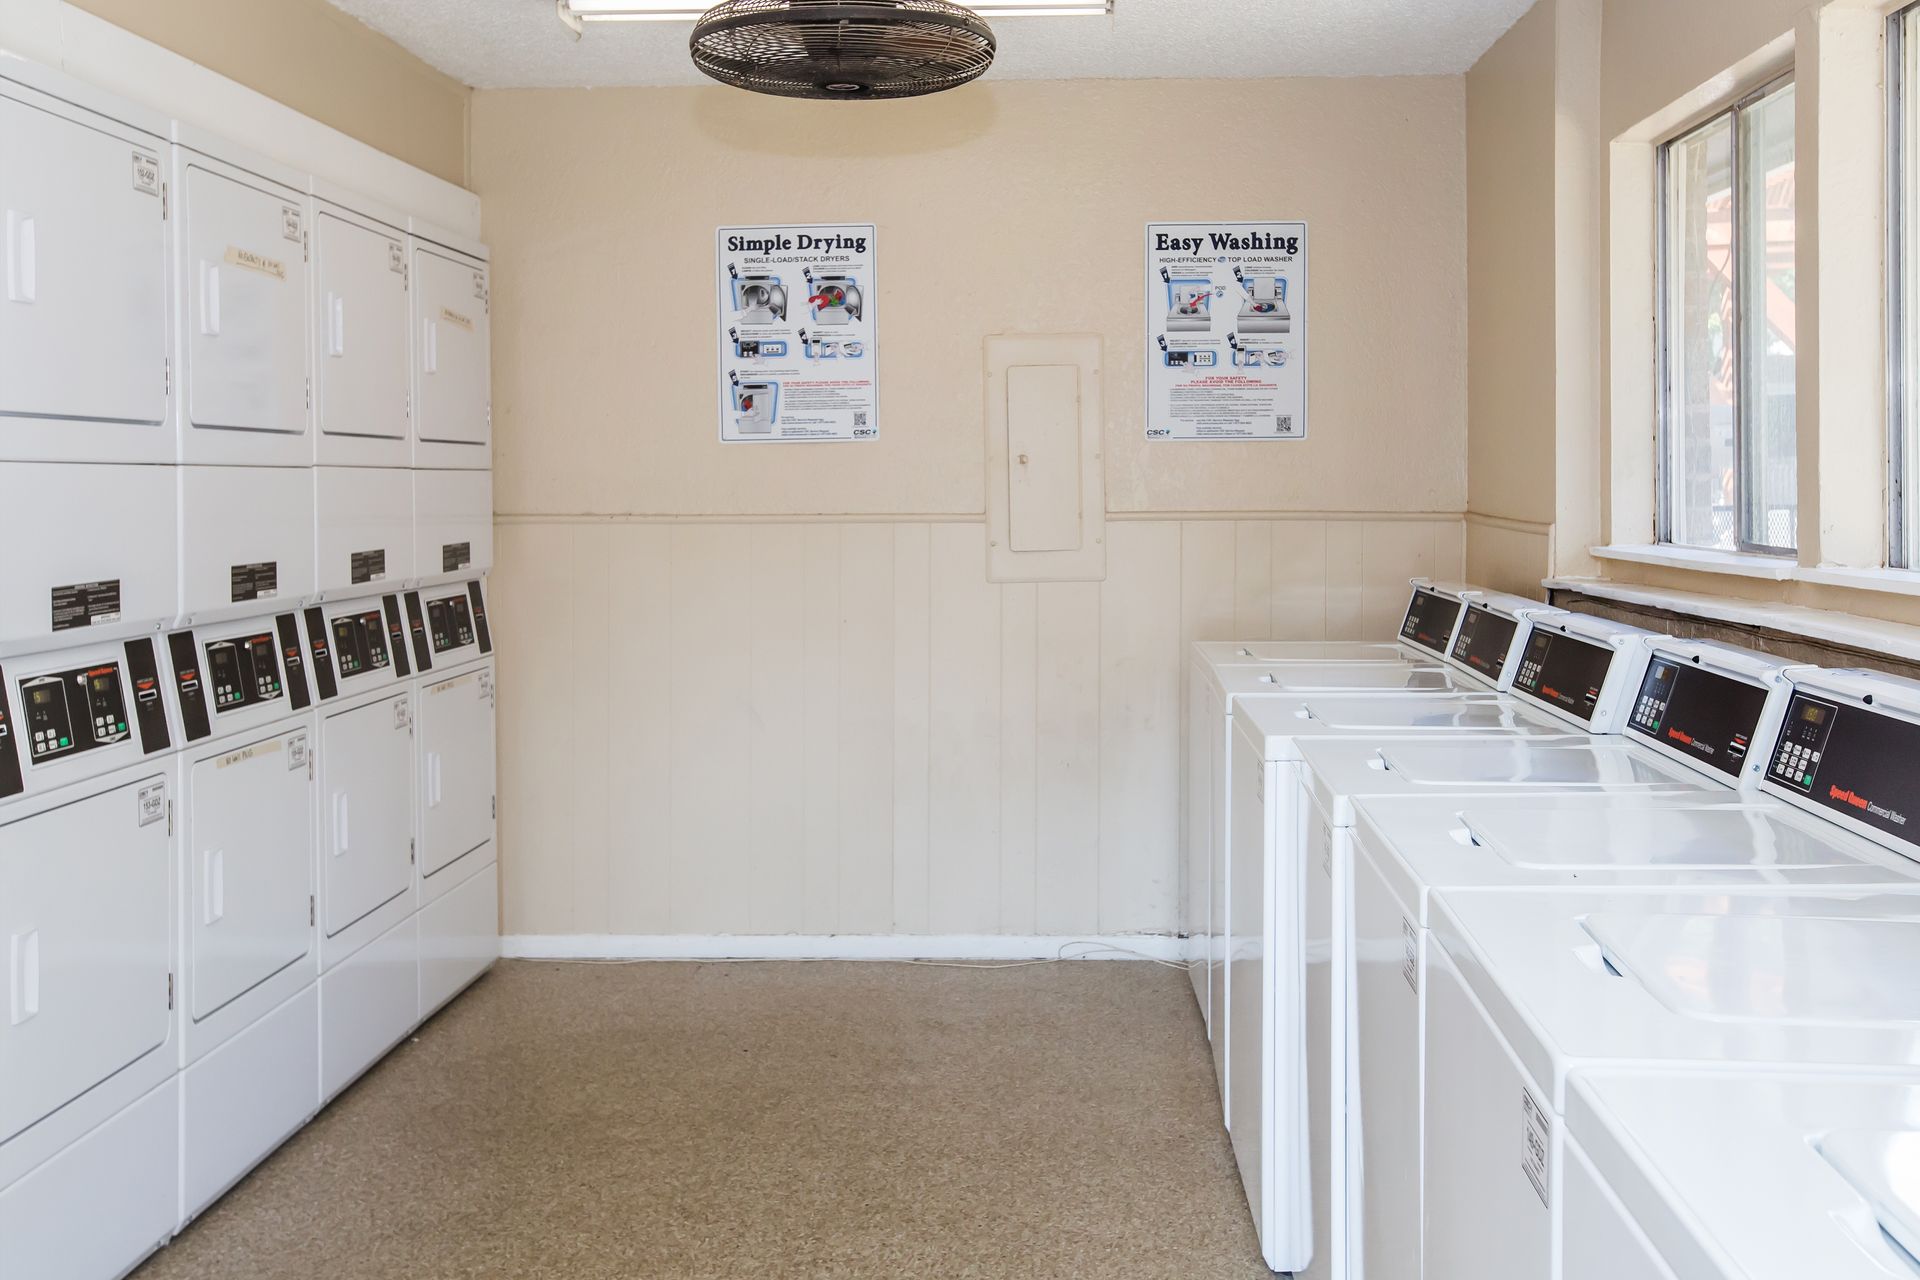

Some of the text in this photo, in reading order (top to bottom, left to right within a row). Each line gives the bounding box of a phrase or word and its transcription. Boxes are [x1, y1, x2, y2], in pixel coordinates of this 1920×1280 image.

[727, 233, 867, 255] Simple Drying
[1155, 231, 1299, 256] Easy Washing
[743, 255, 850, 264] SINGLE-LOAD/STACK DRYERS
[1159, 256, 1217, 264] HIGH-EFFICIENCY
[1867, 801, 1891, 819] Commercial
